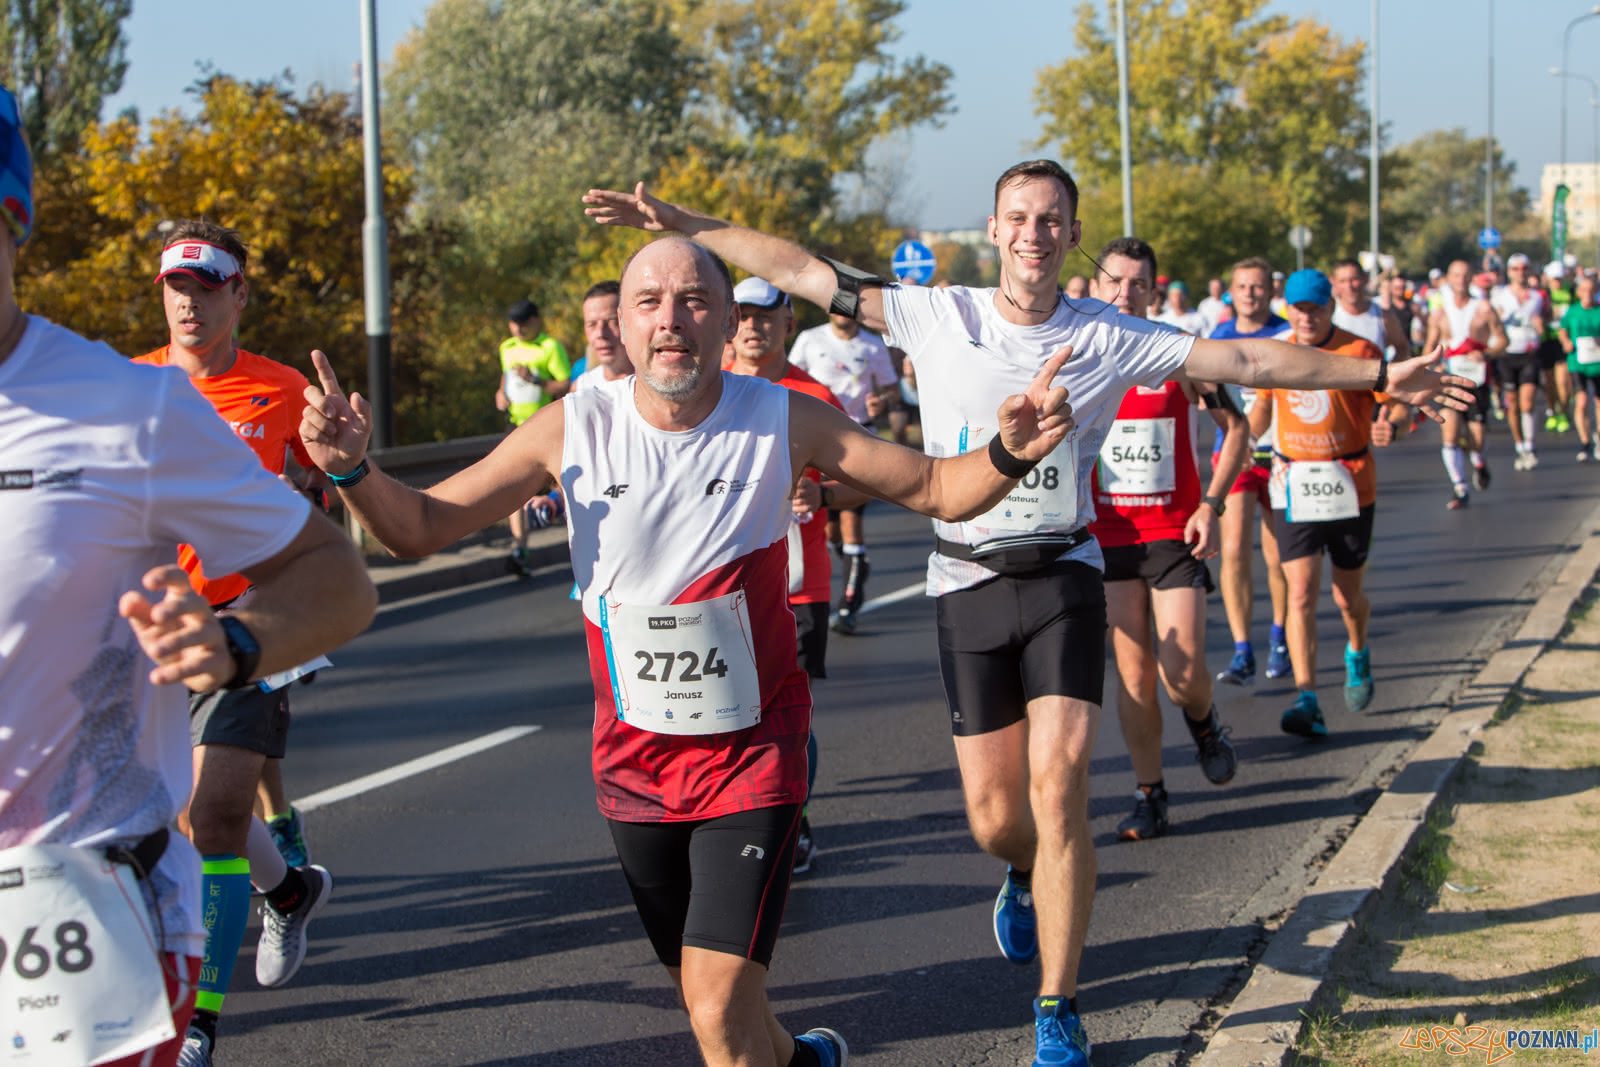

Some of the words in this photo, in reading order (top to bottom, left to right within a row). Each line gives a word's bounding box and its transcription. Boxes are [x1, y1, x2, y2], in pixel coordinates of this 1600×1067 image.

[1112, 446, 1162, 463] 5443
[1301, 481, 1345, 496] 3506
[634, 647, 729, 682] 2724
[663, 690, 704, 700] Janusz
[17, 994, 61, 1011] Piotr
